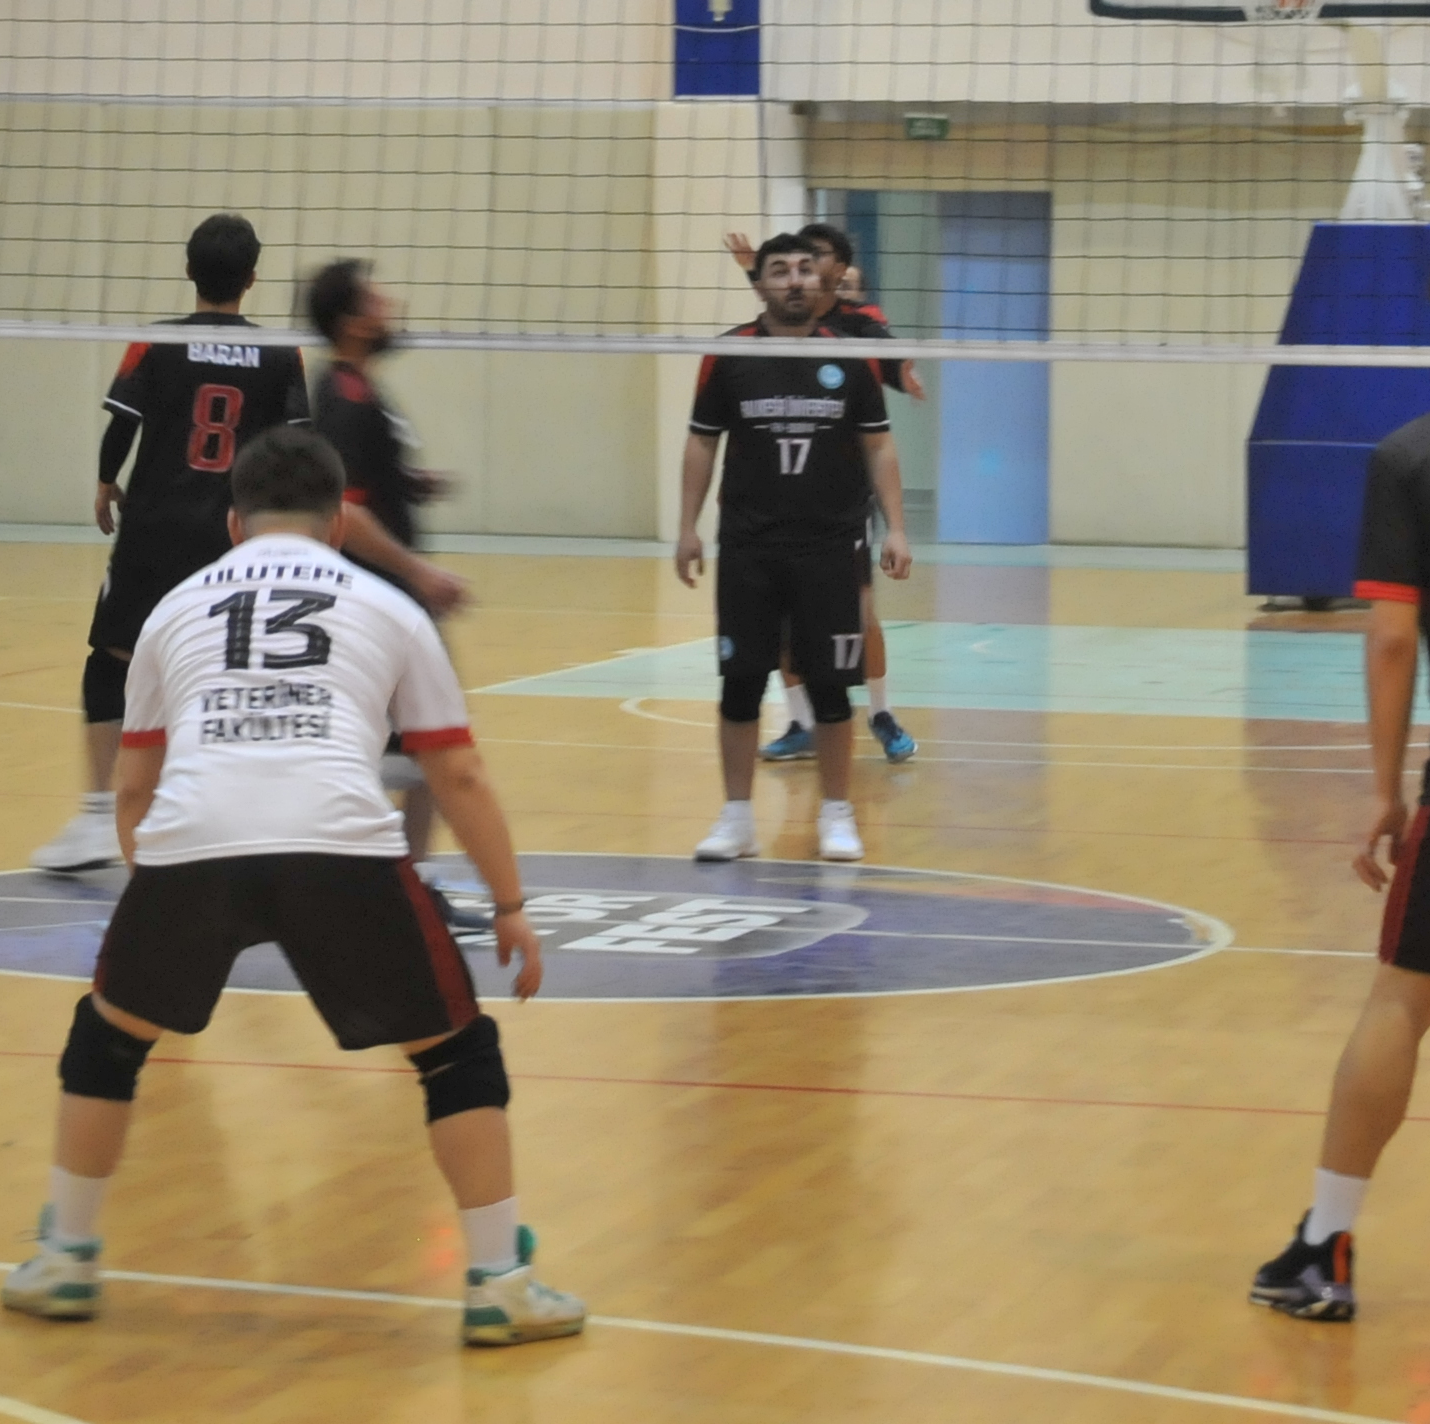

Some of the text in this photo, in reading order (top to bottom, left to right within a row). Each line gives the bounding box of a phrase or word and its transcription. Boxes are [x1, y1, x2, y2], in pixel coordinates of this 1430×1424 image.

[186, 382, 245, 473] 8
[775, 438, 812, 475] 17
[208, 589, 338, 670] 13
[831, 633, 863, 670] 17
[558, 897, 814, 955] FEST
